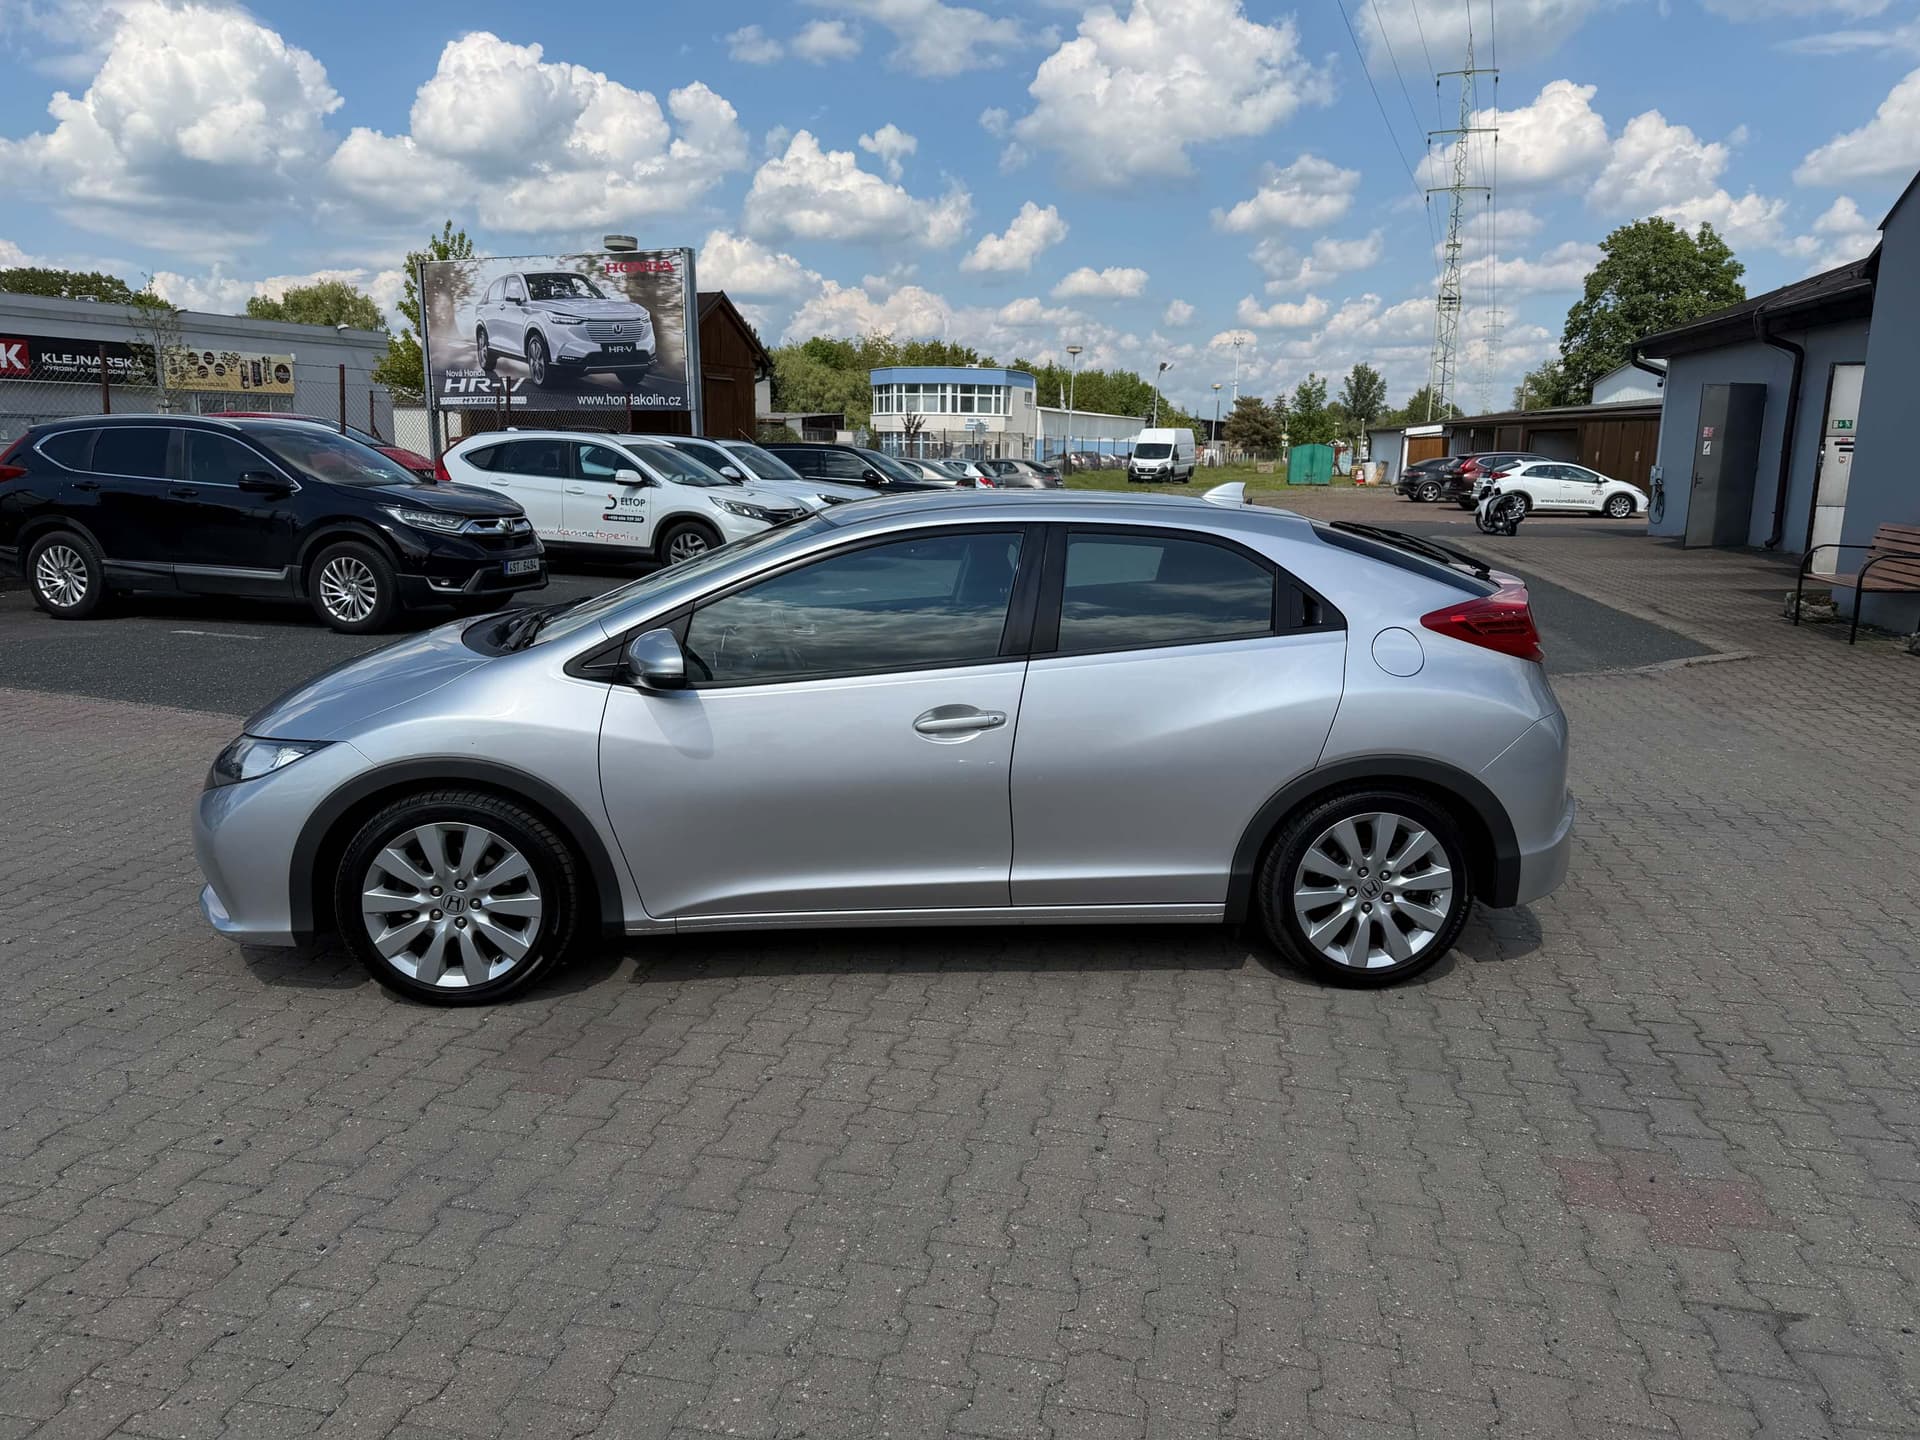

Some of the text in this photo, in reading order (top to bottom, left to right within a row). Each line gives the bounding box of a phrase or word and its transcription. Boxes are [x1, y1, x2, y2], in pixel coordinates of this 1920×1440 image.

[604, 260, 674, 273] HONDA
[446, 368, 486, 378] Nová Honda
[444, 377, 526, 393] HR-V
[620, 497, 646, 507] ELTOP
